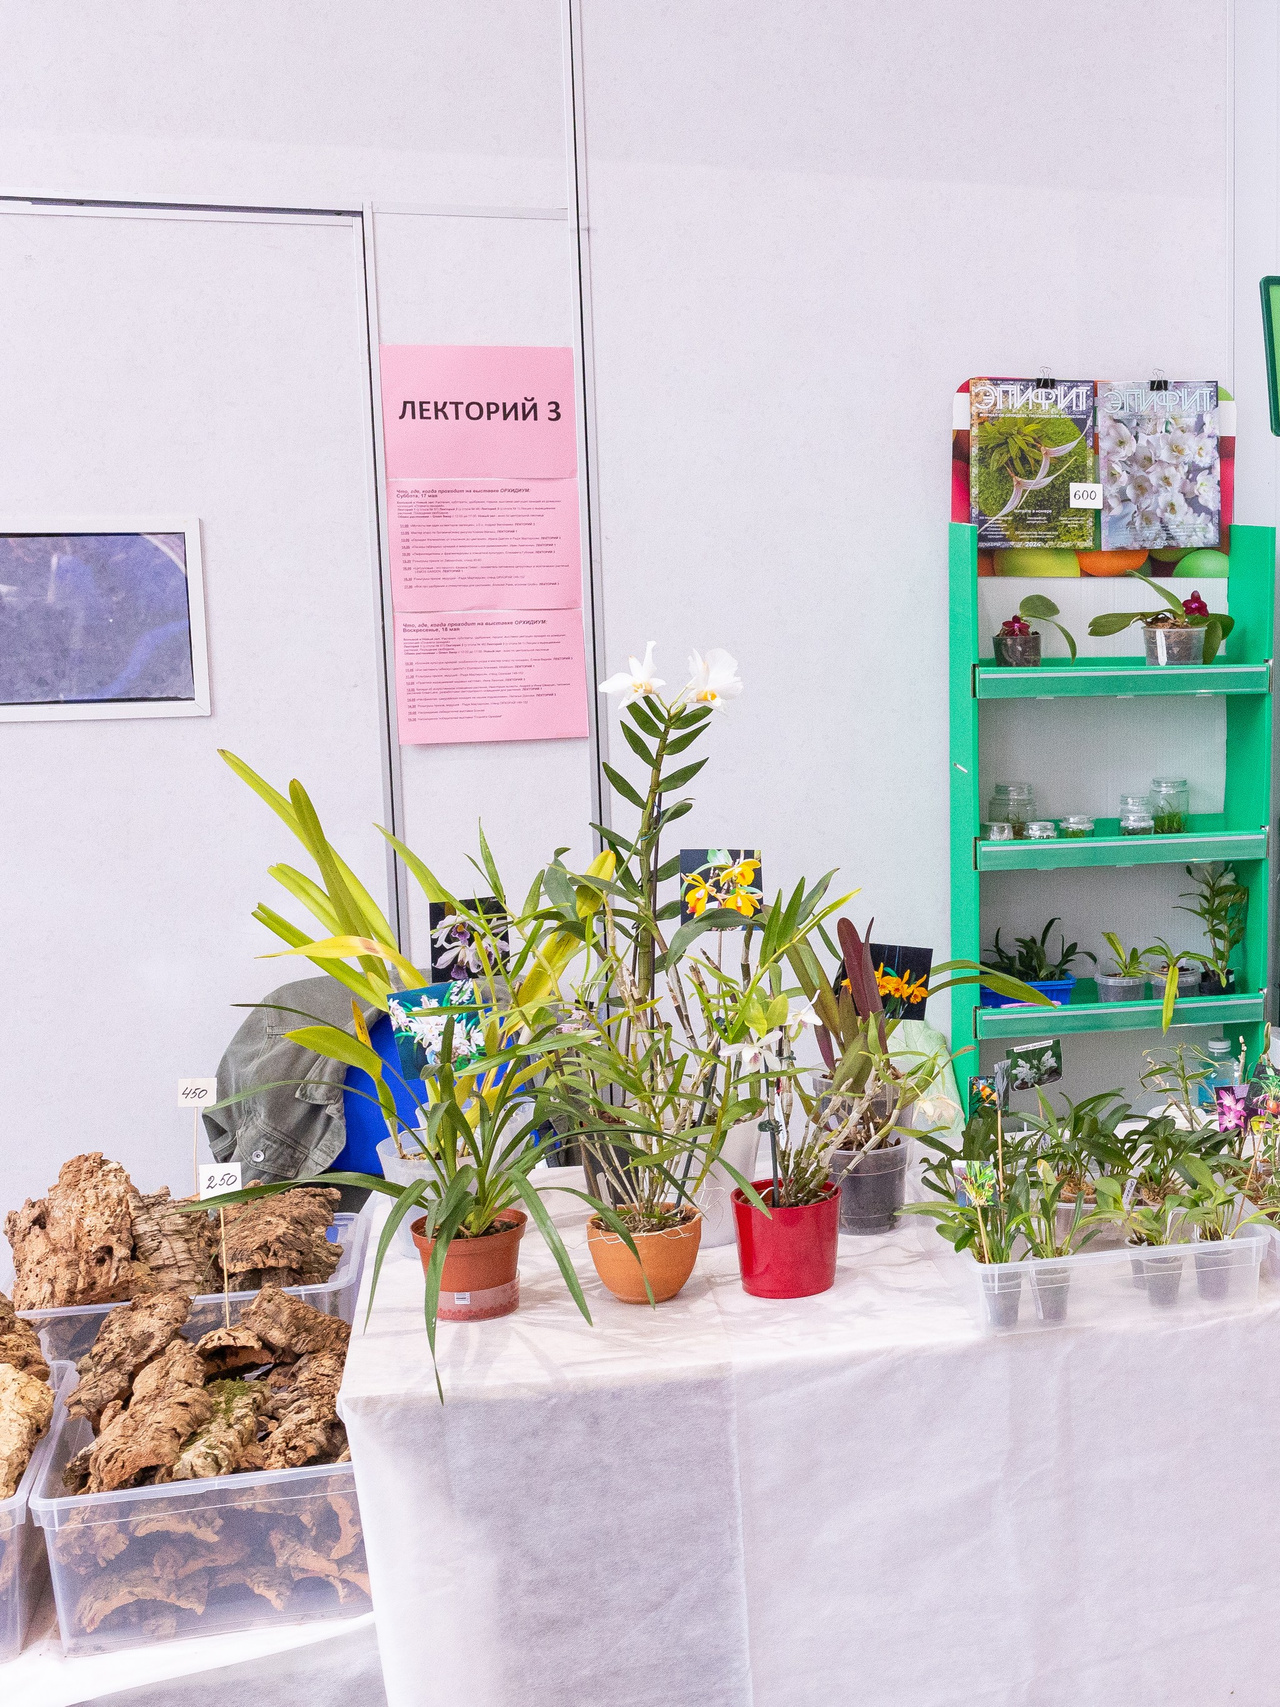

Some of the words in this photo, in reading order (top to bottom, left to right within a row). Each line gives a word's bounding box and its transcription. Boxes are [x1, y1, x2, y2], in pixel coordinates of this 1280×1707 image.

[974, 384, 1091, 411] ЭПИФИТ
[1103, 388, 1214, 414] ЭПИФИТ
[399, 396, 538, 421] ЛЕКТОРИЙ
[547, 401, 562, 422] 3
[1073, 489, 1097, 501] 600
[181, 1086, 208, 1099] 450
[206, 1172, 238, 1190] 250
